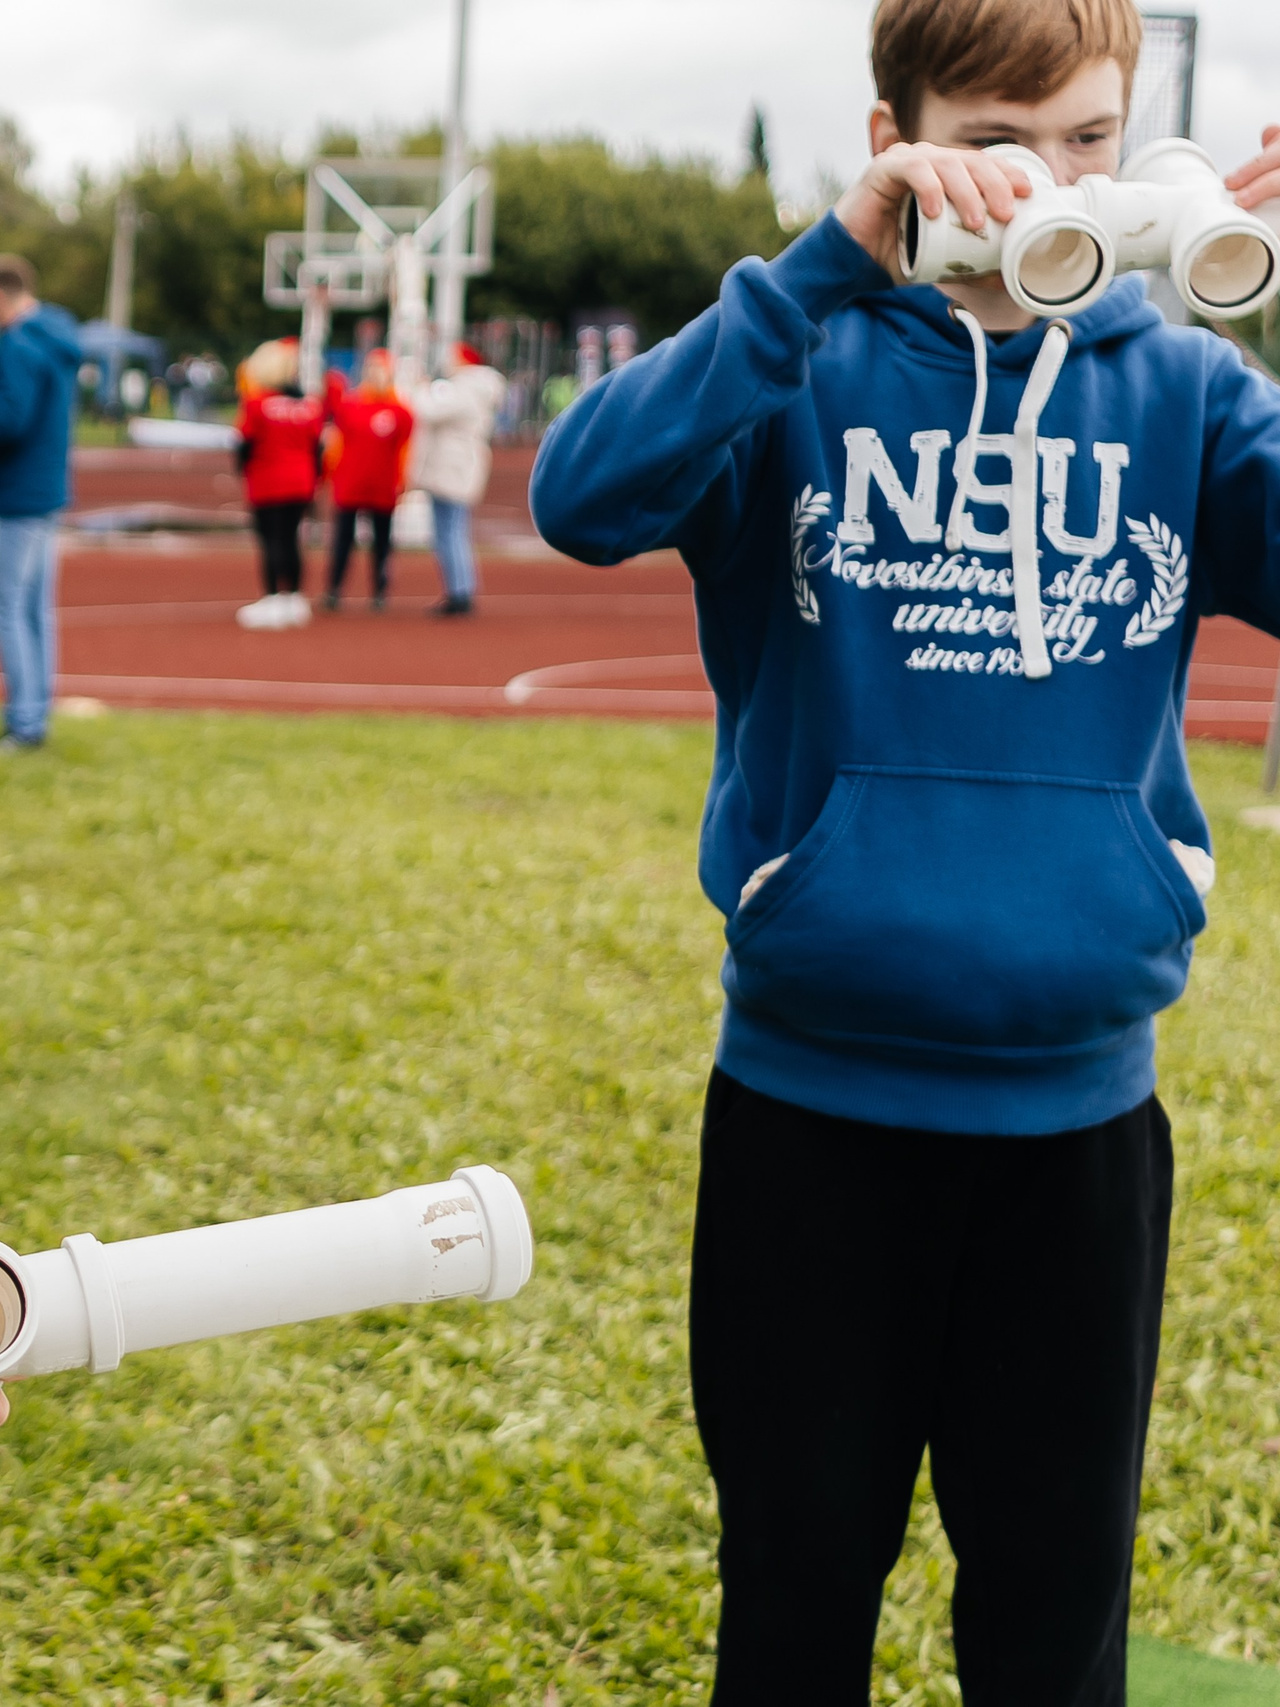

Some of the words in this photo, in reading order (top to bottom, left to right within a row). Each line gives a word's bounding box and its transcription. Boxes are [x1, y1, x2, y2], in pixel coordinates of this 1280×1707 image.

[836, 426, 1130, 560] NSU
[803, 531, 1044, 598] Novosibirs
[1041, 554, 1139, 607] state
[904, 641, 985, 674] since
